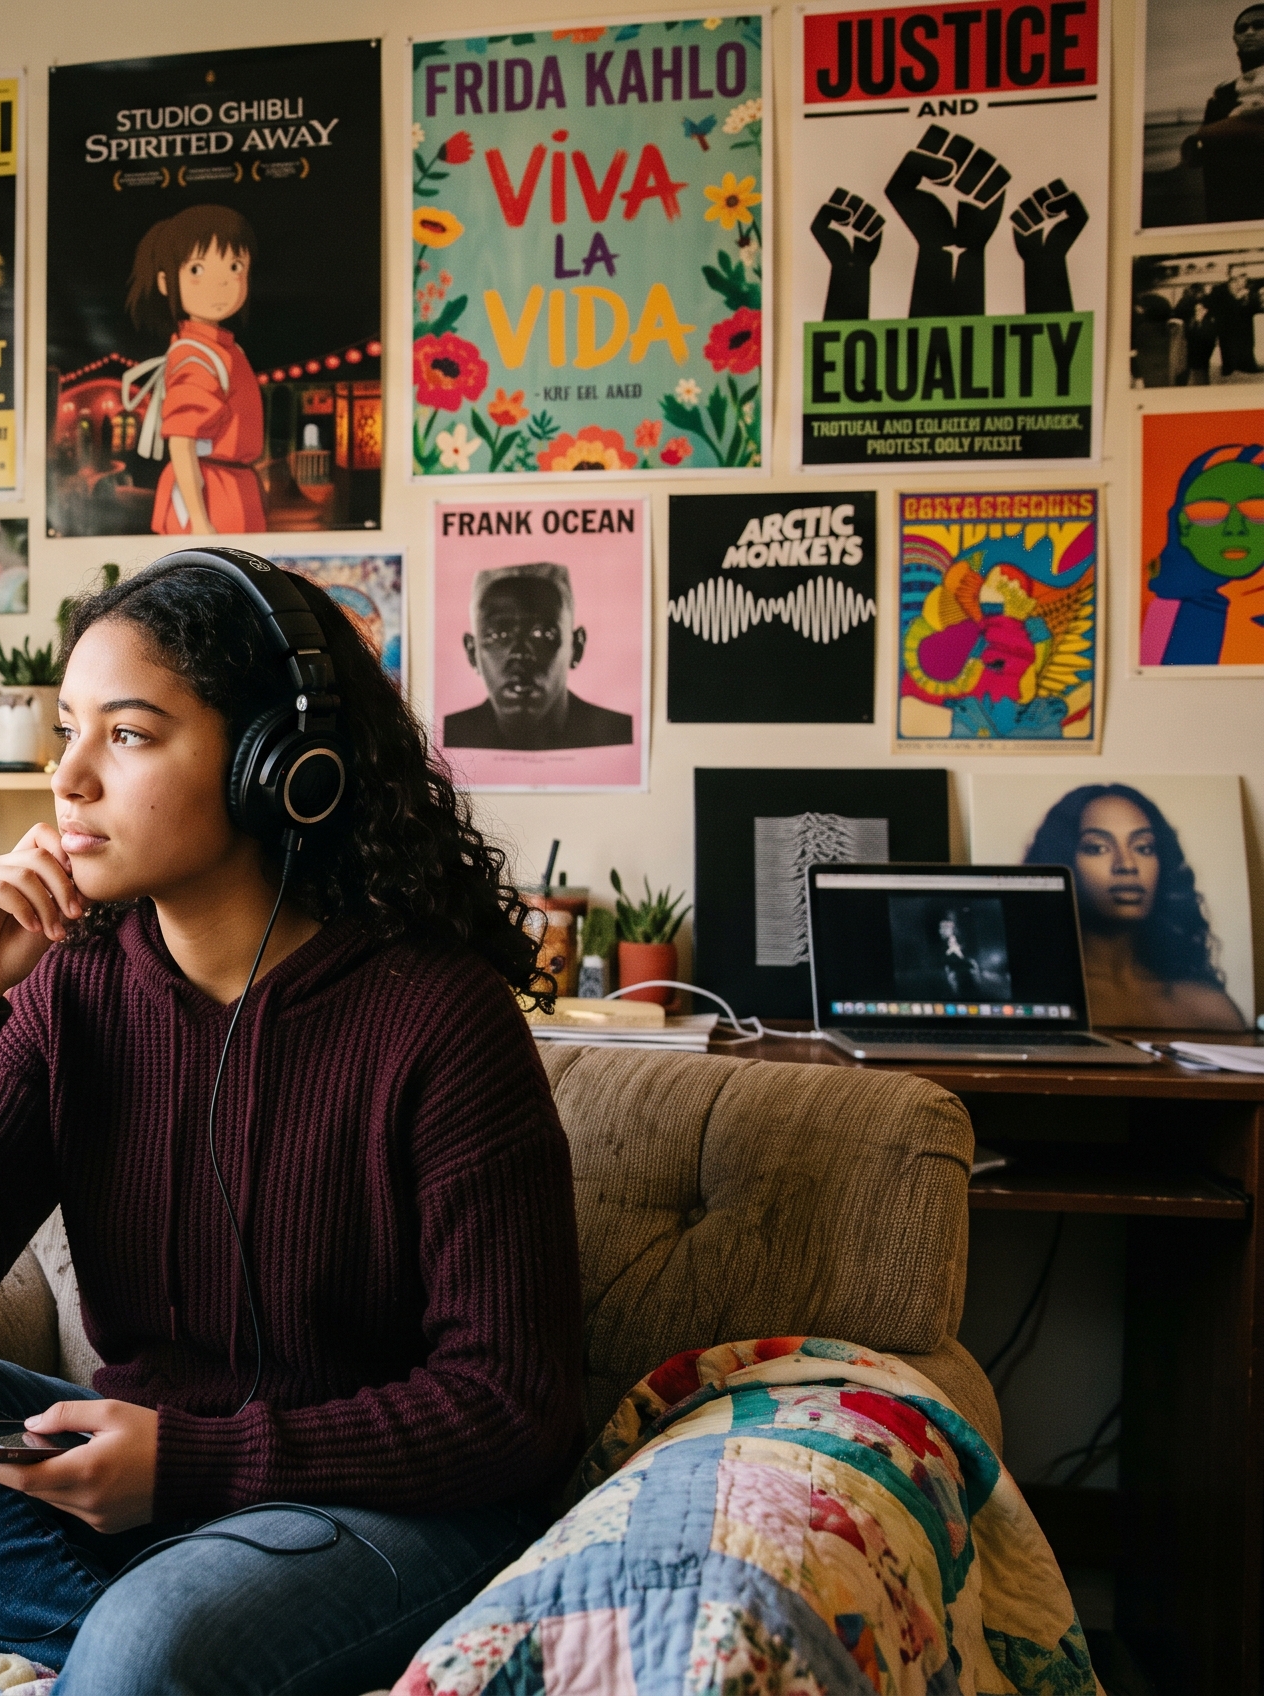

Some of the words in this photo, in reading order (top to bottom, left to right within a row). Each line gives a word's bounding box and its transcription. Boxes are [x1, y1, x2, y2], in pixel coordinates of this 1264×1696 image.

[816, 1, 1087, 99] JUSTICE
[425, 54, 567, 118] FRIDA
[585, 41, 748, 107] KAHLO
[116, 103, 213, 132] STUDIO
[218, 97, 303, 124] GHIBLI
[916, 99, 979, 117] AND
[85, 131, 234, 163] SPIRITED
[240, 118, 339, 151] AWAY
[554, 231, 620, 279] LA
[483, 282, 697, 370] VIDA
[811, 320, 1084, 405] EQUALITY
[984, 415, 1014, 432] AND
[442, 510, 533, 536] FRANK
[542, 507, 635, 534] OCEAN
[736, 504, 855, 545] ARCTIC
[721, 535, 864, 569] MONKEYS
